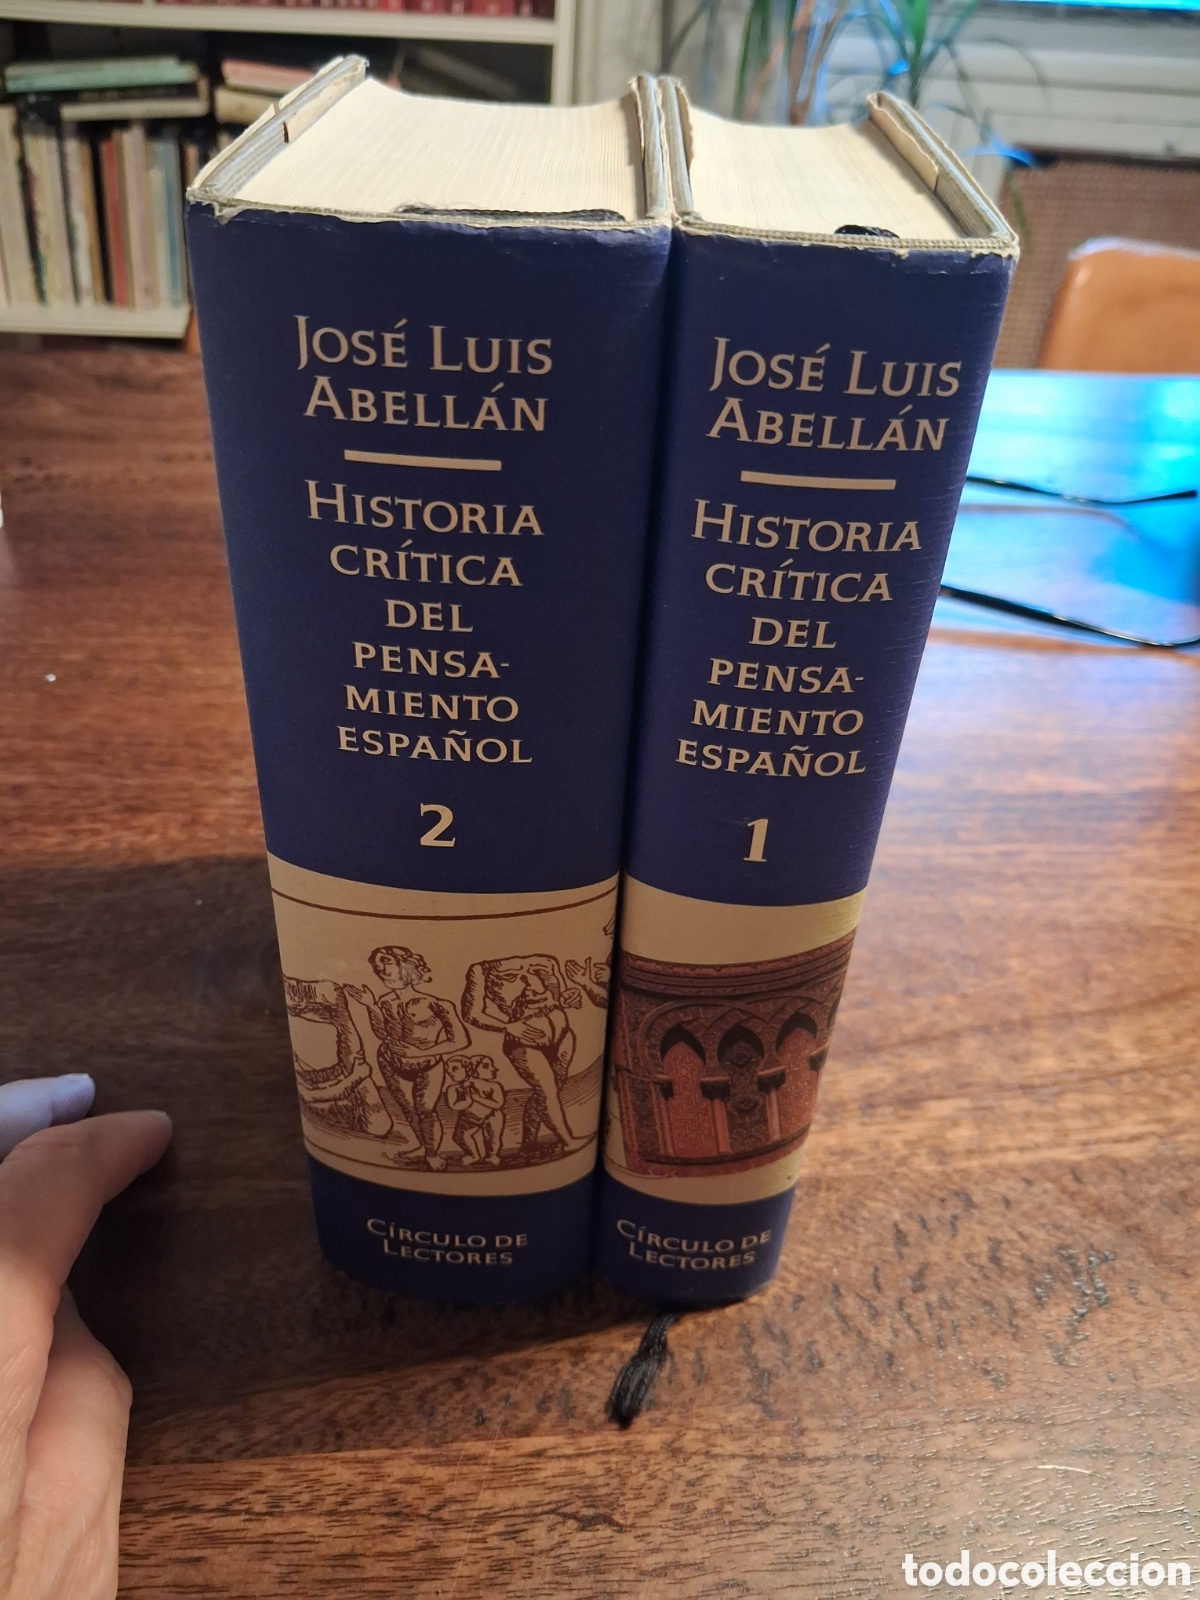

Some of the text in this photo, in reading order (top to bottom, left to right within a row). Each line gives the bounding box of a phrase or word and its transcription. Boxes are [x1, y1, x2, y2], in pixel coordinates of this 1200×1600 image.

[295, 315, 553, 375] JOSÉ LUIS
[709, 336, 962, 398] JOSÉ LUIS
[303, 375, 547, 432] ABELLÁN
[706, 397, 948, 452] ABELLÁN
[305, 480, 544, 537] HISTORIA
[691, 498, 923, 553] HISTORIA
[329, 539, 522, 588] CRÍTICA
[704, 558, 893, 603] CRÍTICA
[385, 599, 474, 633] DEL
[748, 616, 837, 650] DEL
[352, 641, 510, 679] PENSA-
[708, 657, 865, 694] PENSA-
[344, 684, 520, 723] MIENTO
[691, 699, 864, 737] MIENTO
[336, 725, 533, 764] ESPAÑOL
[675, 738, 867, 777] ESPAÑOL
[419, 802, 456, 848] 2
[742, 818, 769, 863] 1
[366, 1217, 529, 1249] CÍRCULO DE
[382, 1237, 514, 1266] LECTORES
[616, 1219, 773, 1253] CÍRCULO DE
[628, 1240, 756, 1271] LECTORES
